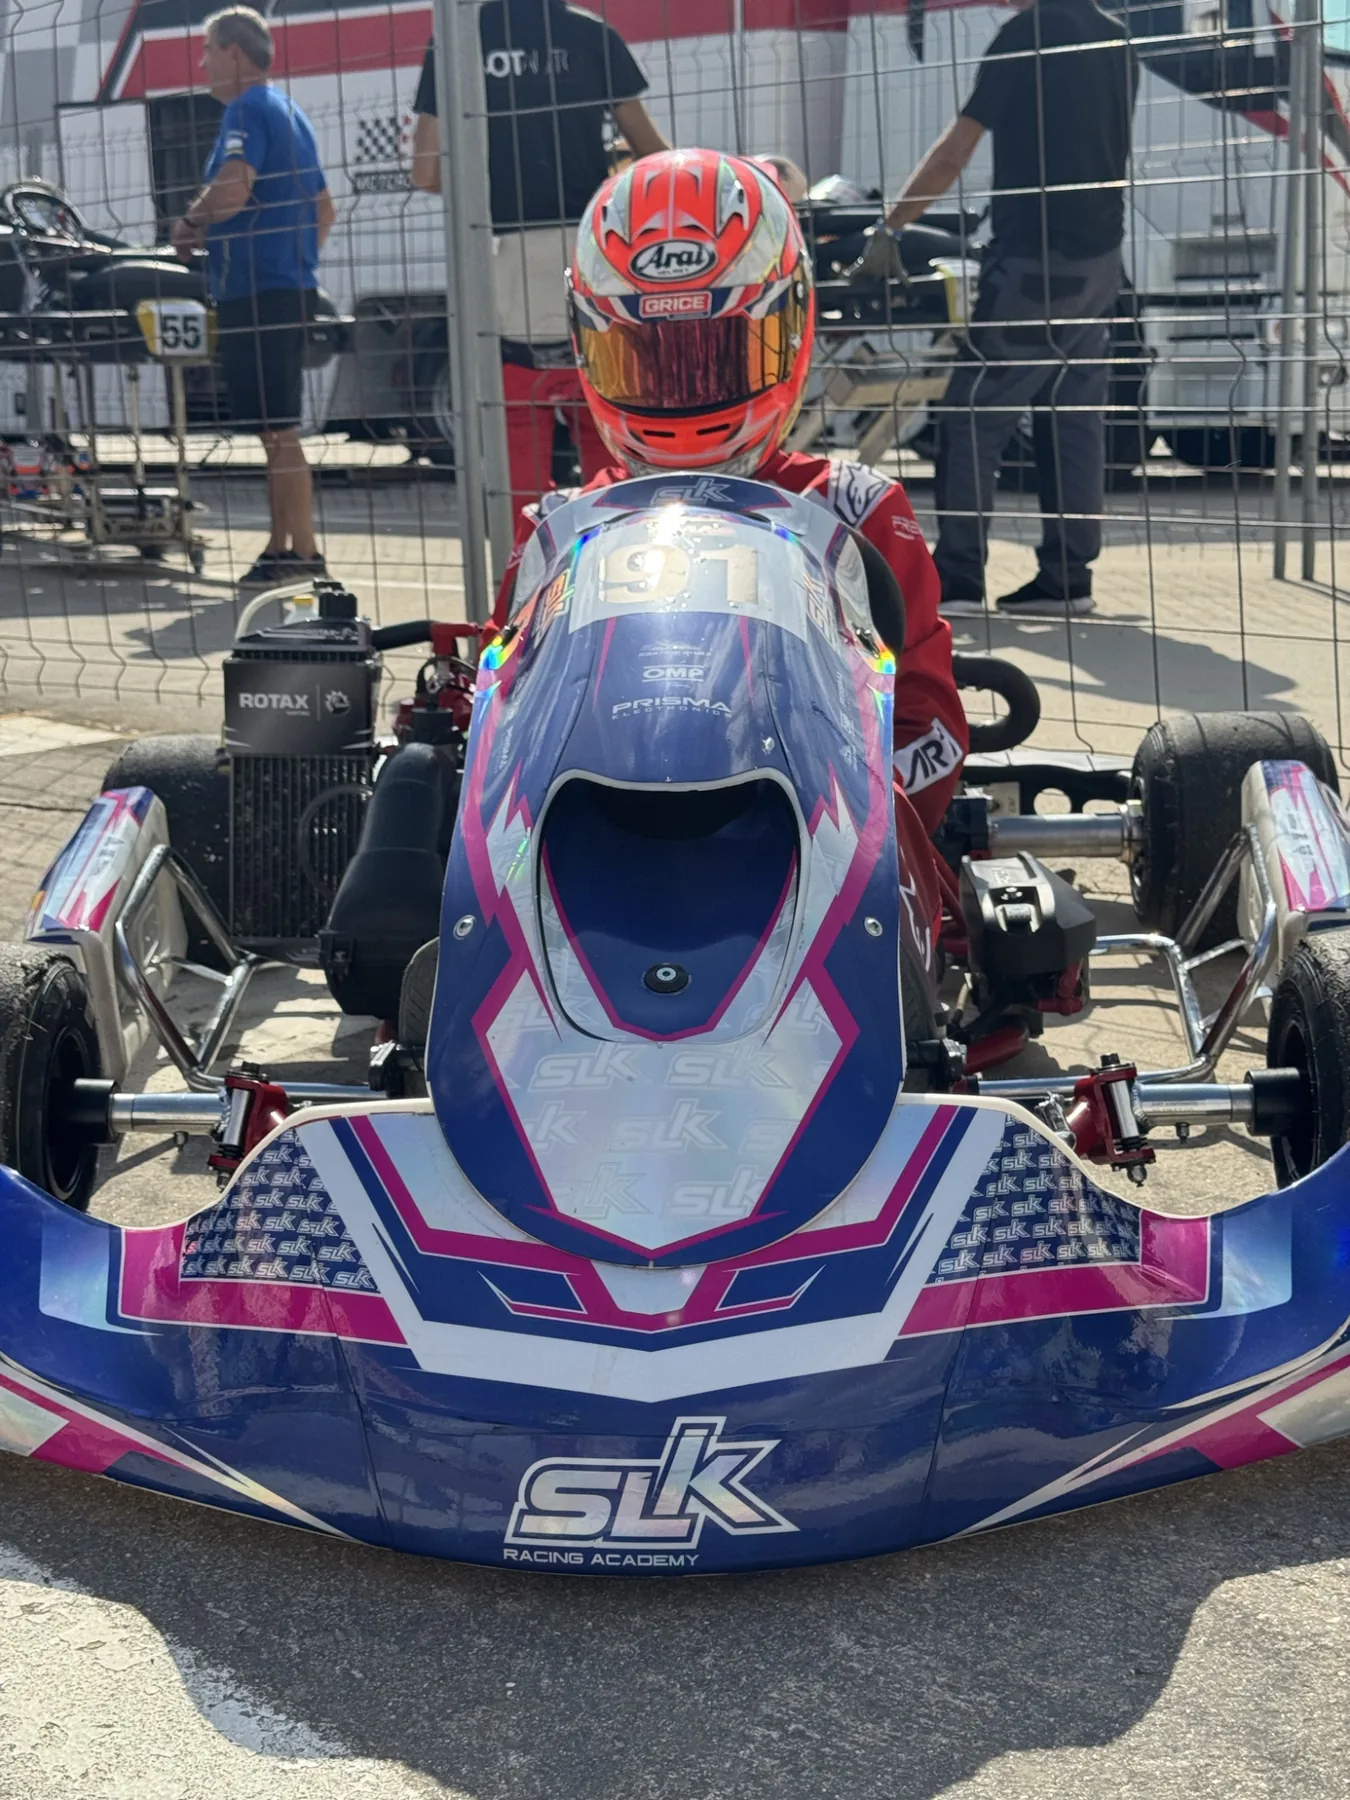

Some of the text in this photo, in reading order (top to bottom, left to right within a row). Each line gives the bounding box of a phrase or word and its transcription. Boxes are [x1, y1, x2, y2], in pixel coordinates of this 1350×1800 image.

[637, 244, 704, 271] Arai
[644, 296, 706, 312] GRICE
[162, 315, 201, 349] 55
[599, 543, 758, 605] 91
[643, 667, 704, 679] OMP
[239, 693, 309, 709] ROTAX
[612, 697, 732, 714] PRISMA
[612, 706, 733, 720] ELECTRONICS
[528, 1036, 651, 1092] SLK
[666, 1040, 793, 1090] SLK
[605, 1099, 728, 1153] SLK
[504, 1416, 800, 1550] SLK
[503, 1549, 699, 1567] RACING ACADEMY
